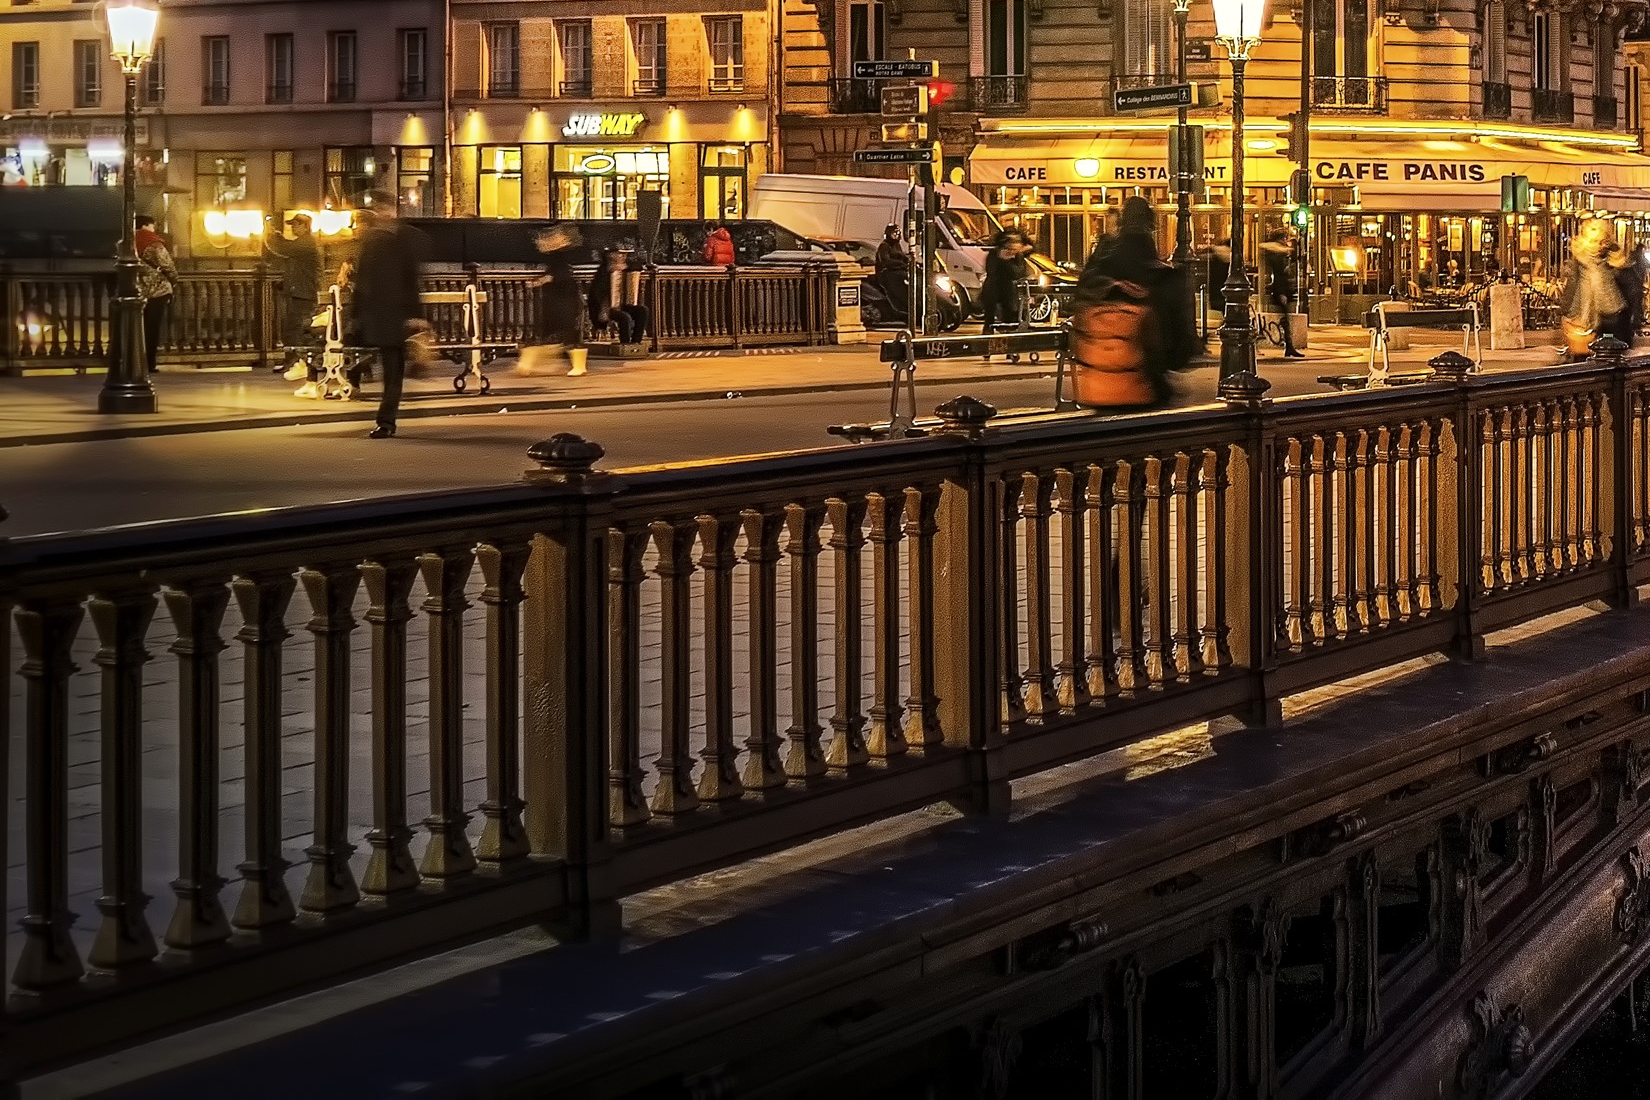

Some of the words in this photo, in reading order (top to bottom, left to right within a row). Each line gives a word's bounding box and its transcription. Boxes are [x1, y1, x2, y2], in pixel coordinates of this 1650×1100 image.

[561, 112, 645, 137] SUBWAY
[1005, 167, 1047, 180] CAFE
[1114, 166, 1227, 180] RESTANT
[1316, 162, 1389, 181] CAFE
[1403, 163, 1485, 182] PANIS
[1582, 172, 1601, 185] CAFE
